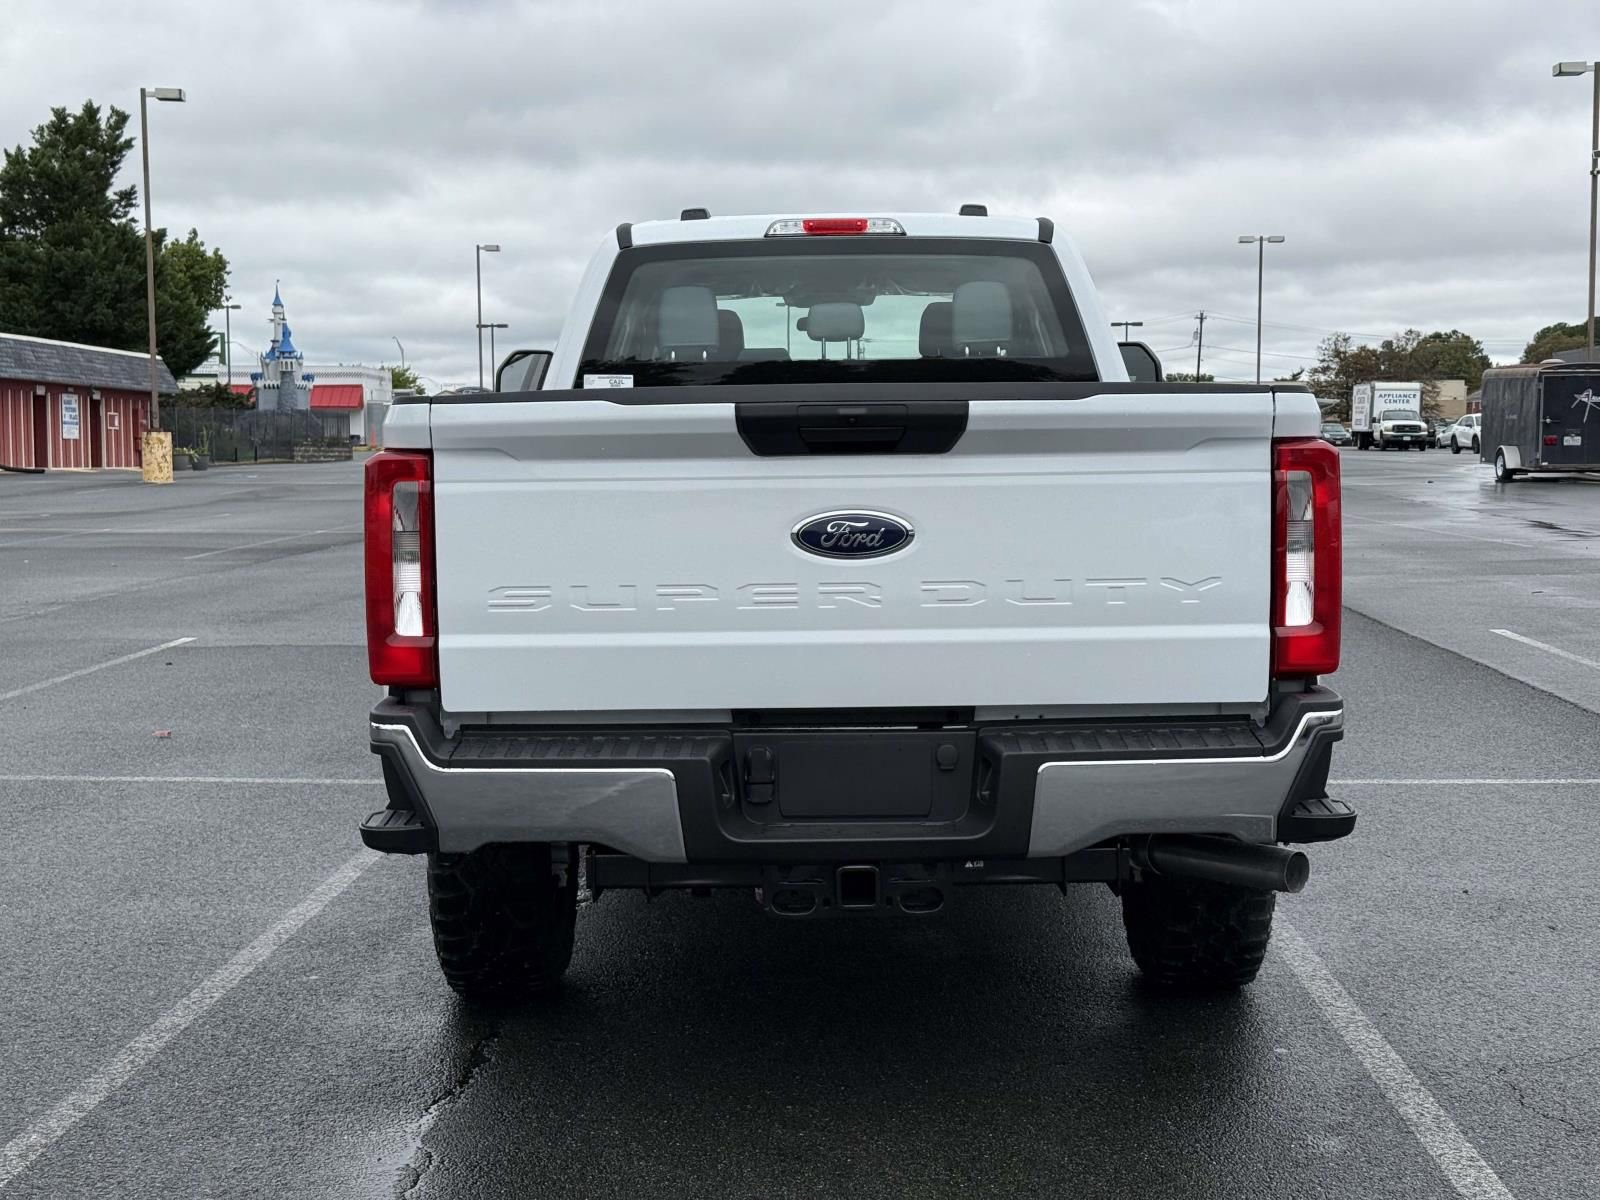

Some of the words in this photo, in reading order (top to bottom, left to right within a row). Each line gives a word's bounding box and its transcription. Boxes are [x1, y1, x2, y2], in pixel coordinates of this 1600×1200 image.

[820, 520, 886, 548] Ford
[487, 581, 883, 613] SUPER
[920, 576, 1224, 607] DUTY
